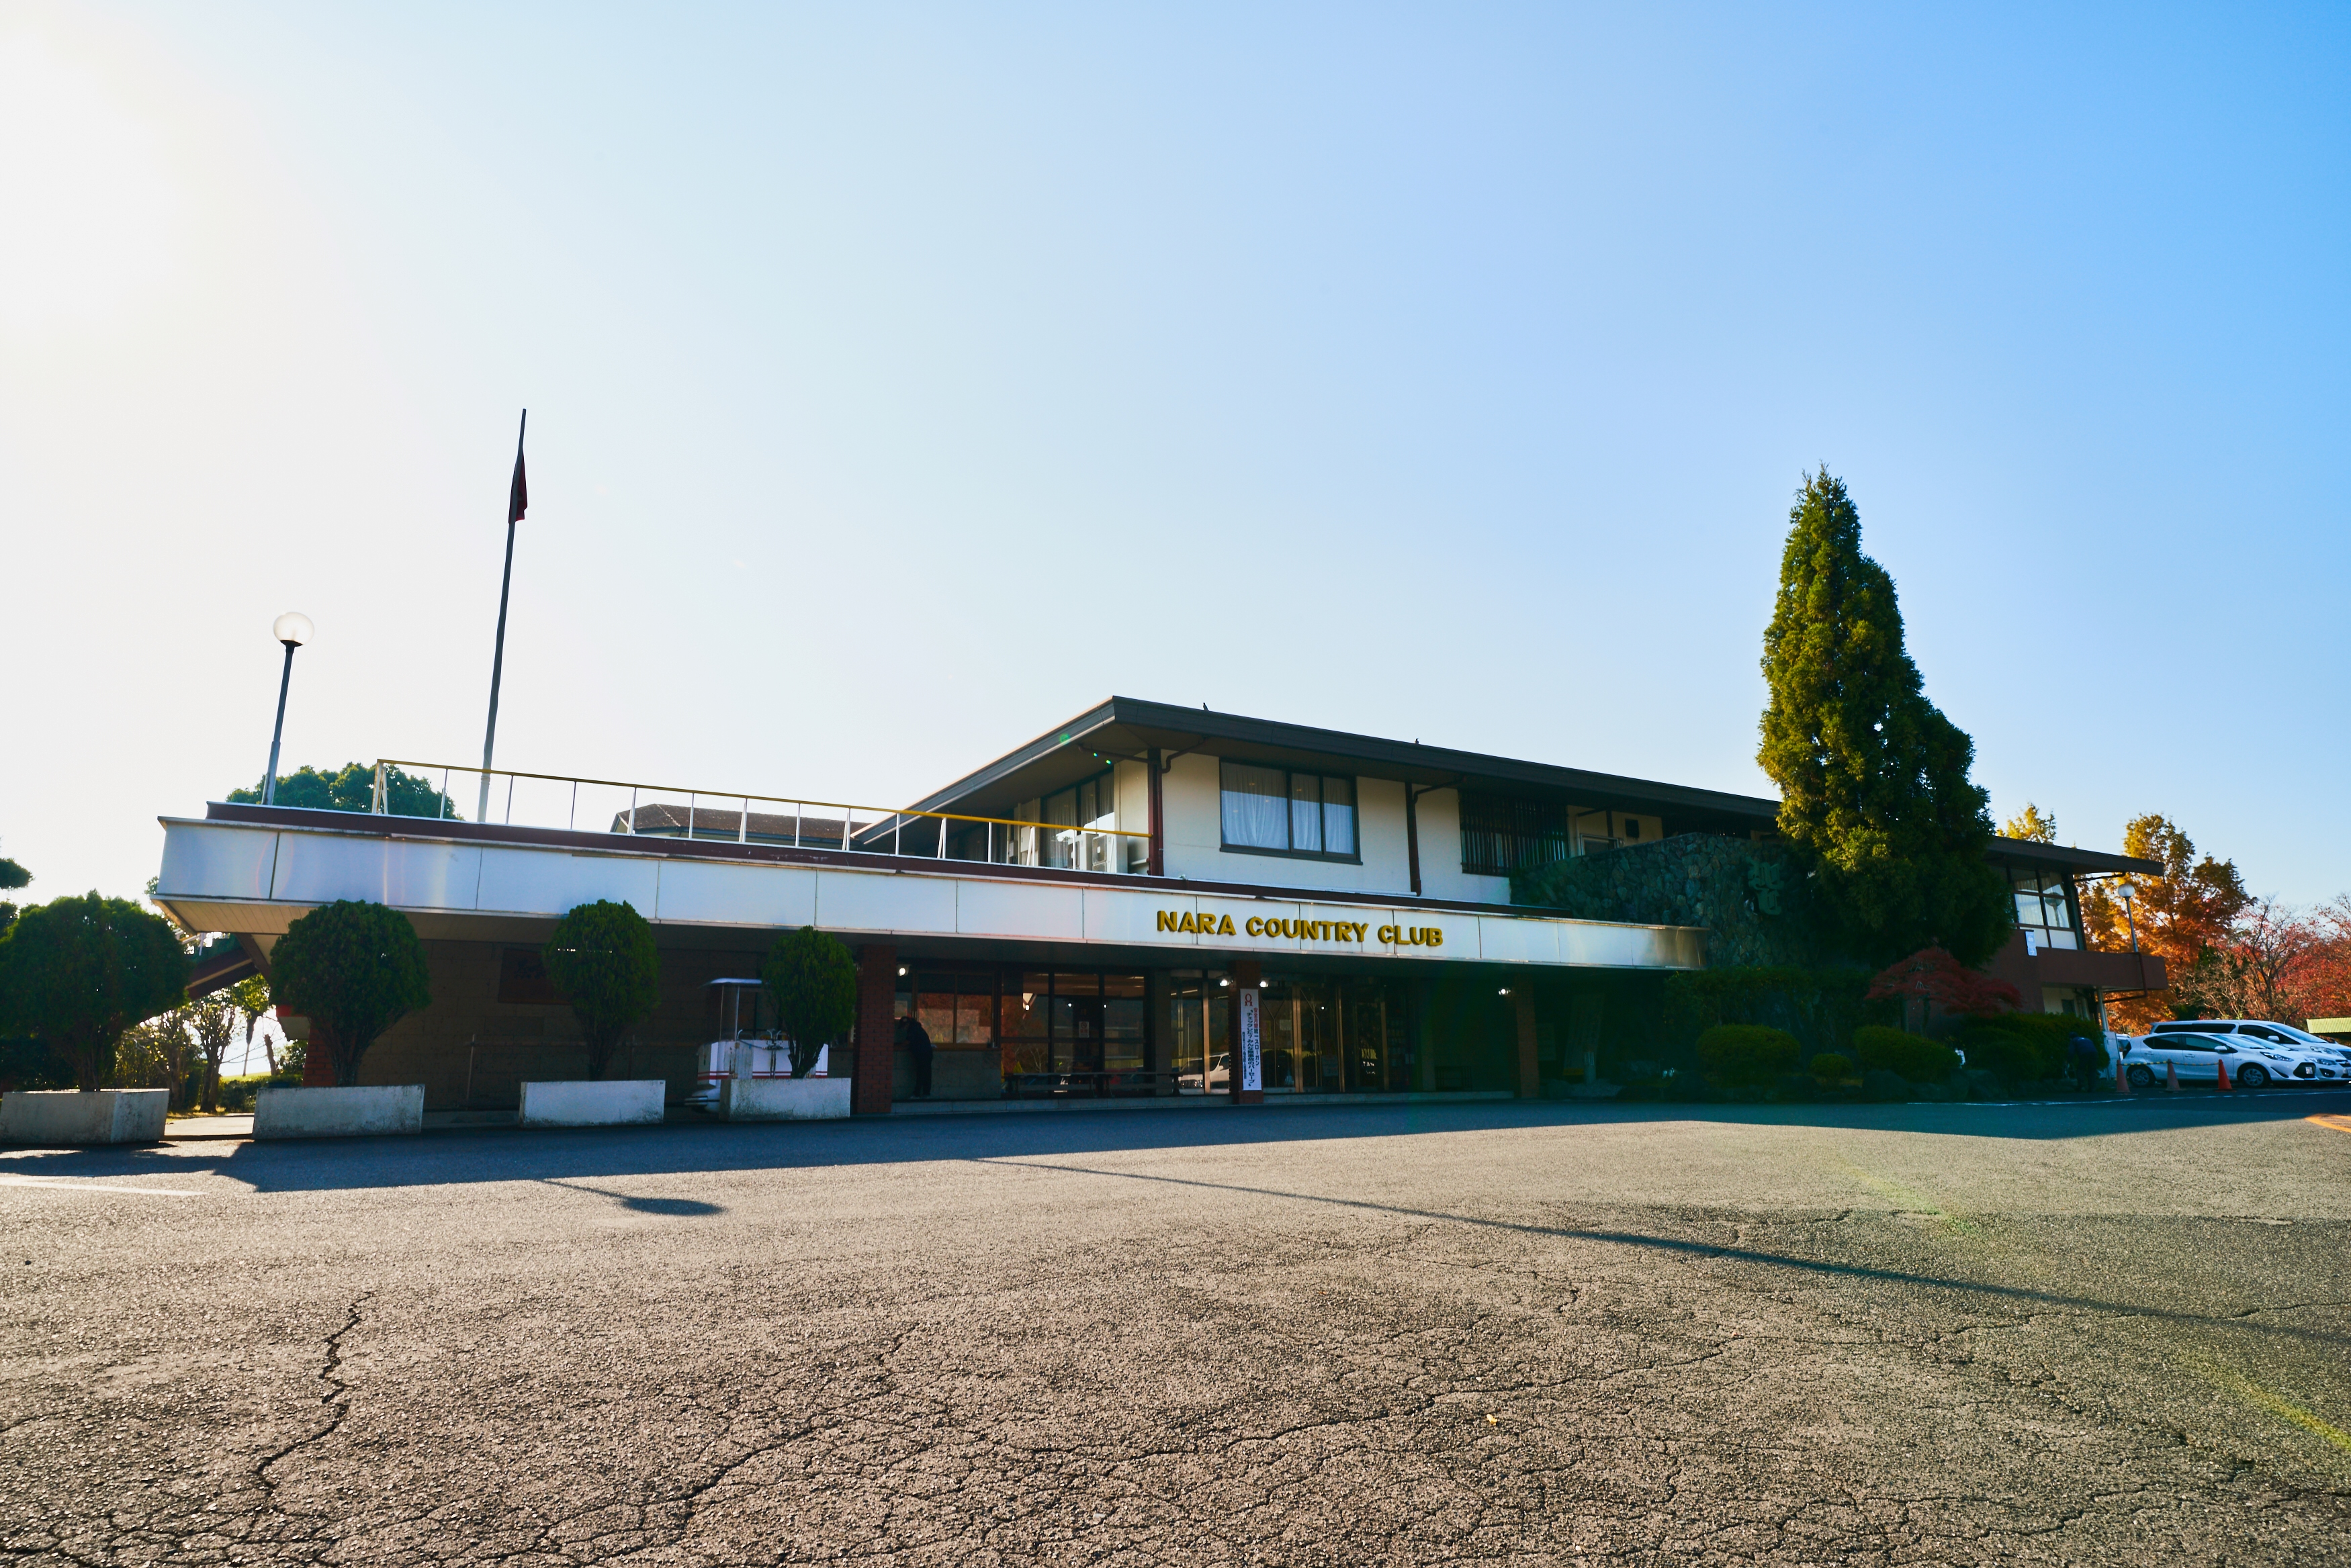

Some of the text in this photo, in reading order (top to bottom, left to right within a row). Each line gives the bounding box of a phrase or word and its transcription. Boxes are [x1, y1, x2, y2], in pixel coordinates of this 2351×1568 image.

[1157, 910, 1444, 947] NARA COUNTRY CLUB
